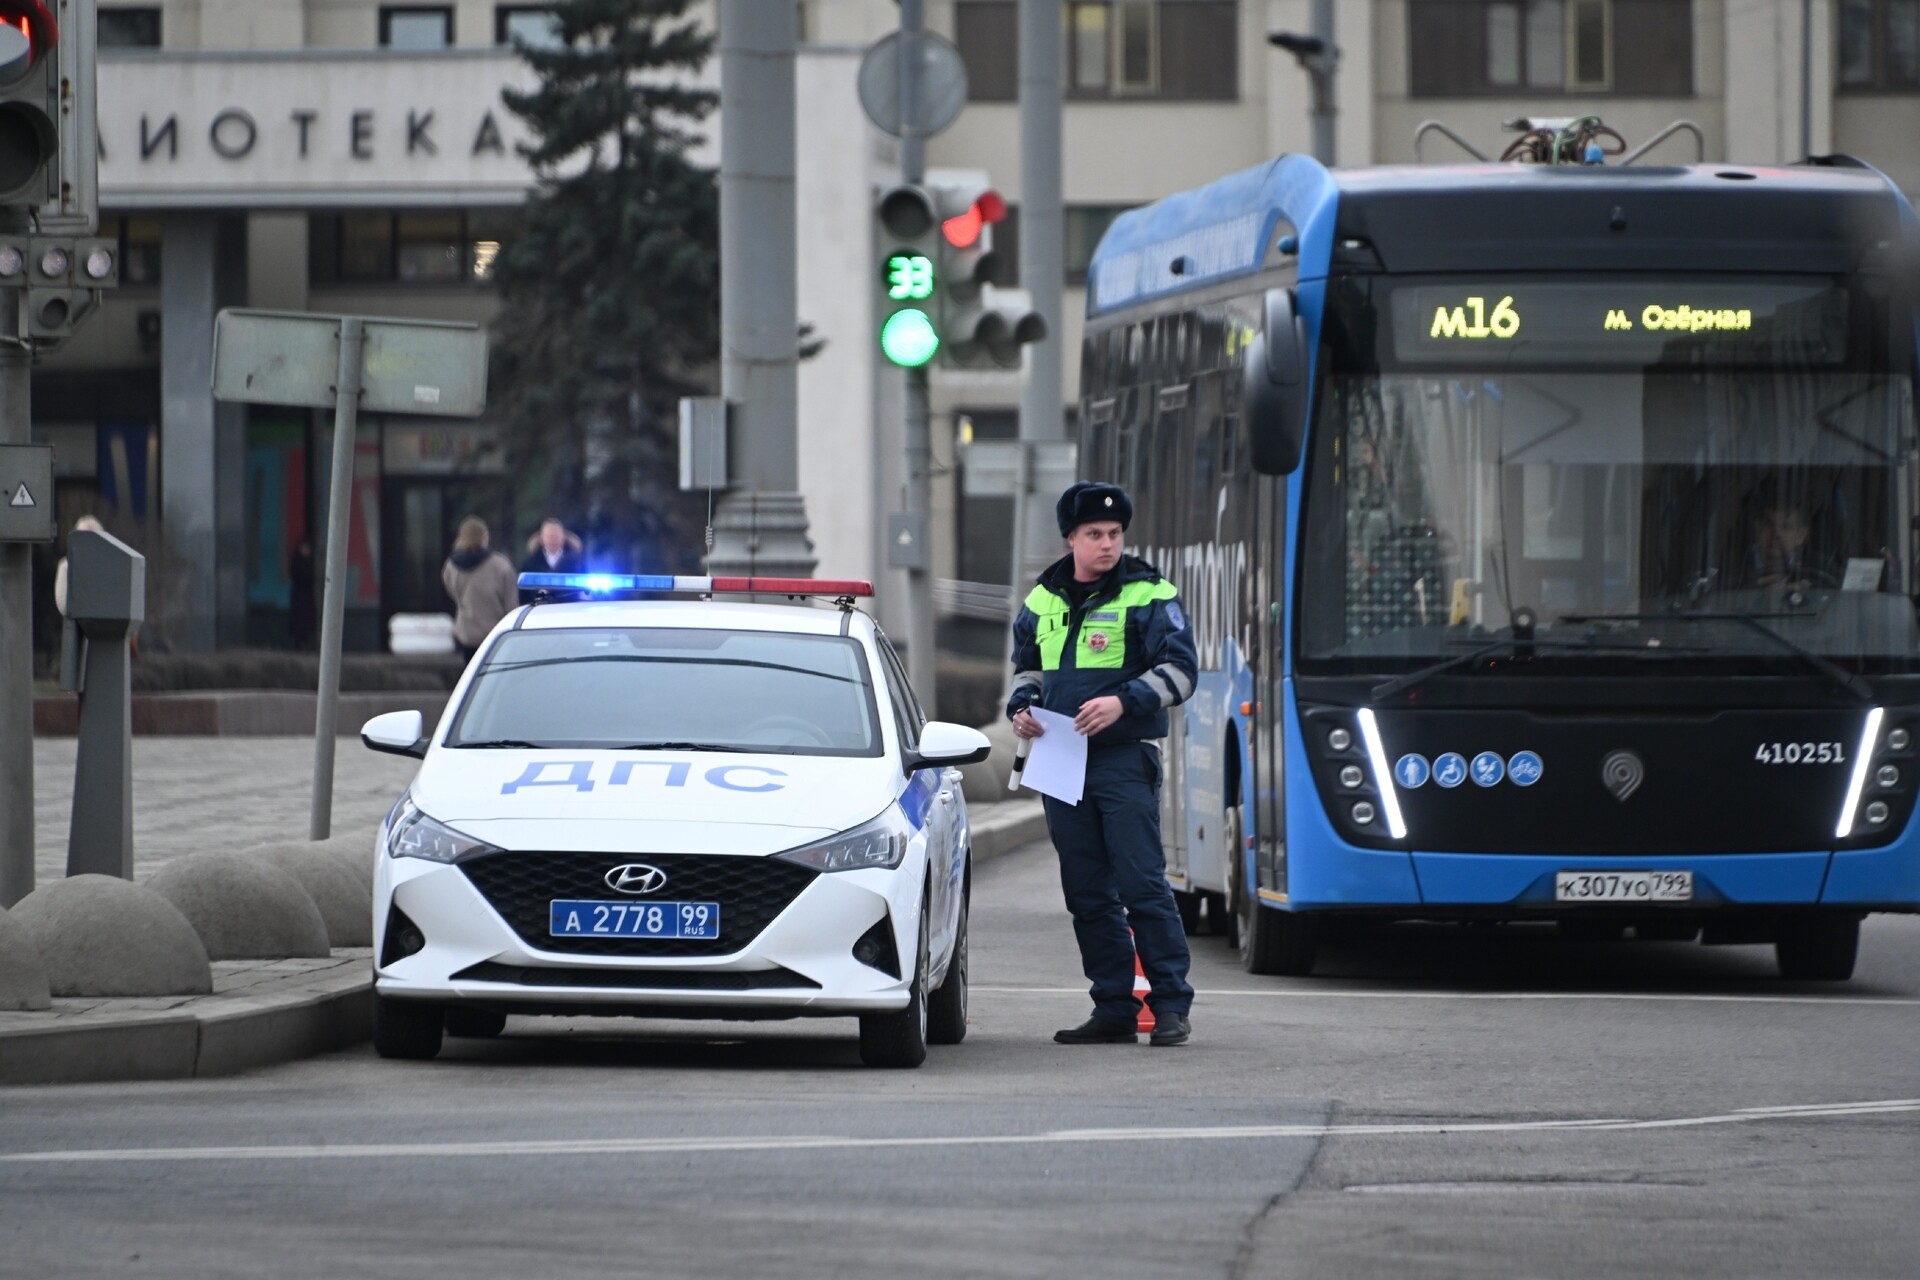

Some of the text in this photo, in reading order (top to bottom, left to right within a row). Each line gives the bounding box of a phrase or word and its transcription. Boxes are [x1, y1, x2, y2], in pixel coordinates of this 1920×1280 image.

[889, 256, 933, 300] 33
[1641, 304, 1752, 332] Озёрная
[1754, 742, 1846, 764] 410251
[500, 760, 789, 795] ДПС
[1651, 873, 1688, 891] 799
[565, 906, 708, 933] А 2778 99
[684, 927, 704, 935] RUS
